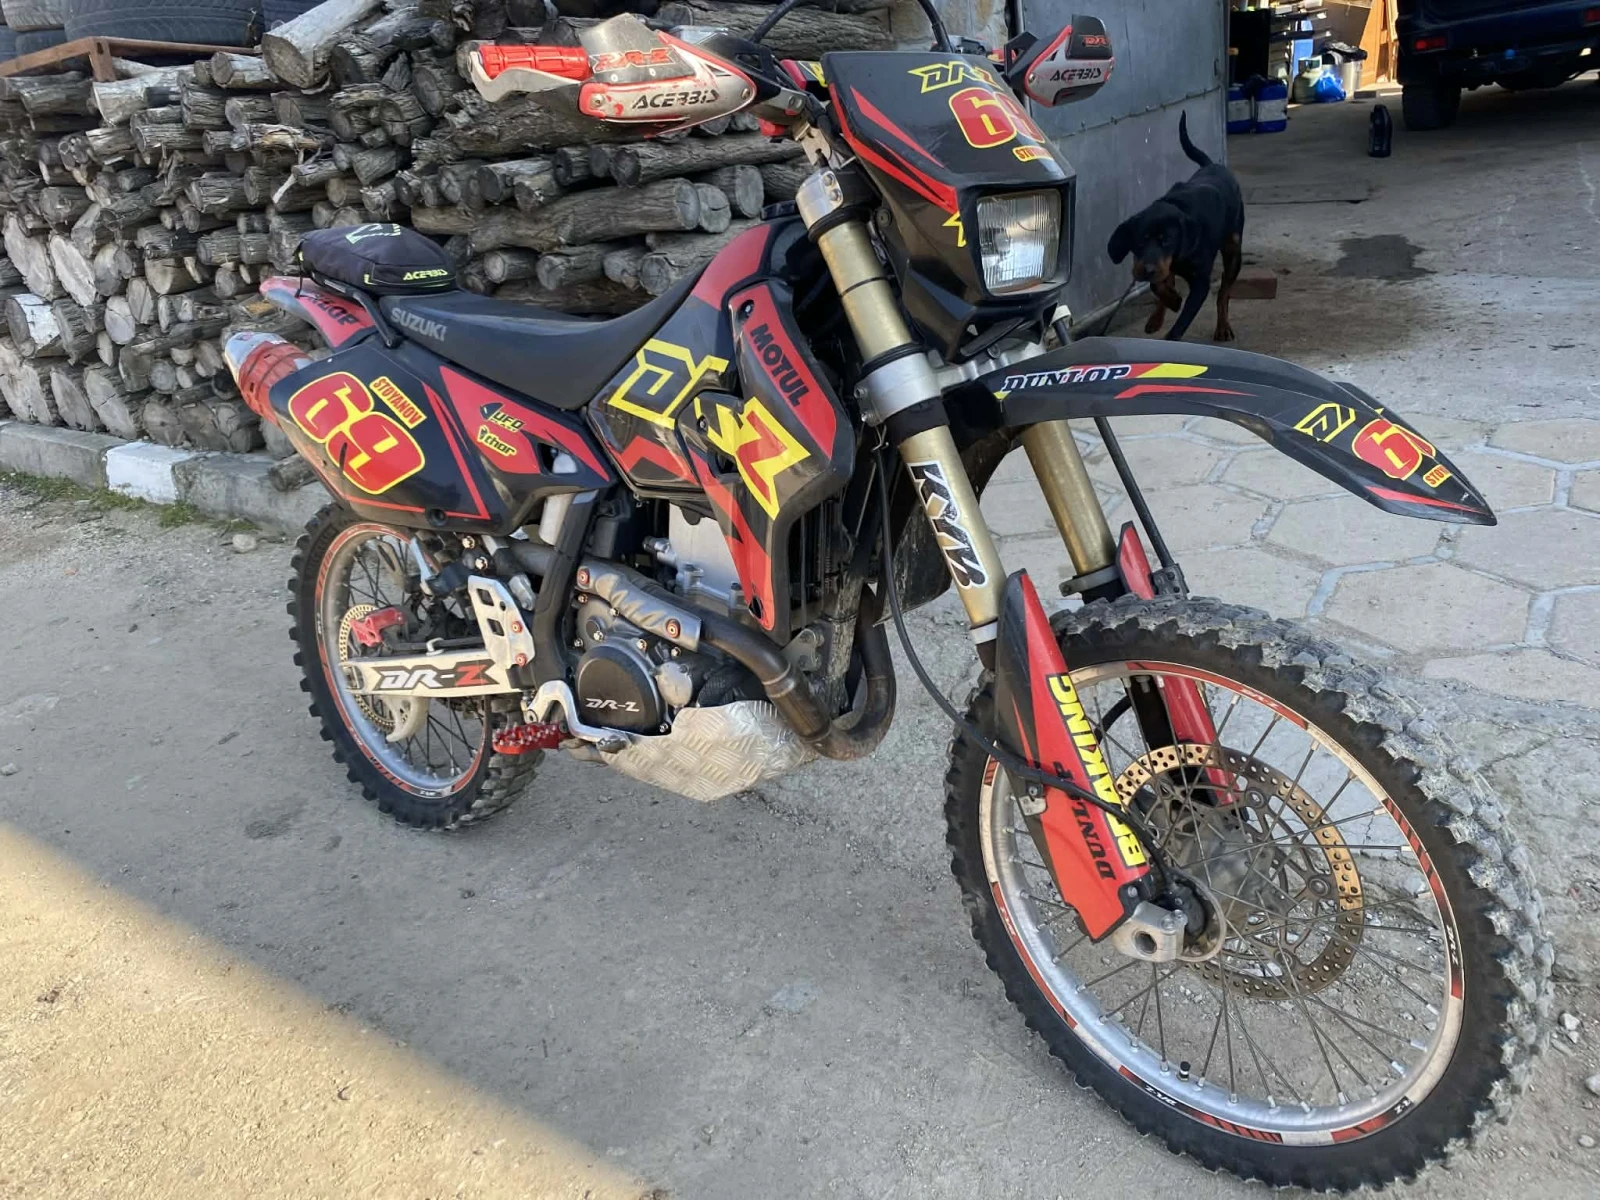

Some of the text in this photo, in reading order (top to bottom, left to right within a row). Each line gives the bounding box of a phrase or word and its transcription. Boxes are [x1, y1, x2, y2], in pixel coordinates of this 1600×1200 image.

[1050, 67, 1101, 81] ACERBIS
[391, 307, 447, 341] SUZUKI
[750, 323, 809, 406] MOTUL
[1000, 365, 1131, 392] DUNLOP
[373, 378, 424, 425] STOYANOV
[288, 371, 425, 494] 69
[491, 411, 525, 429] UFO
[907, 461, 988, 588] KYB
[380, 664, 490, 690] DR-Z
[585, 697, 640, 712] DR-Z
[1052, 760, 1117, 881] DUNLP
